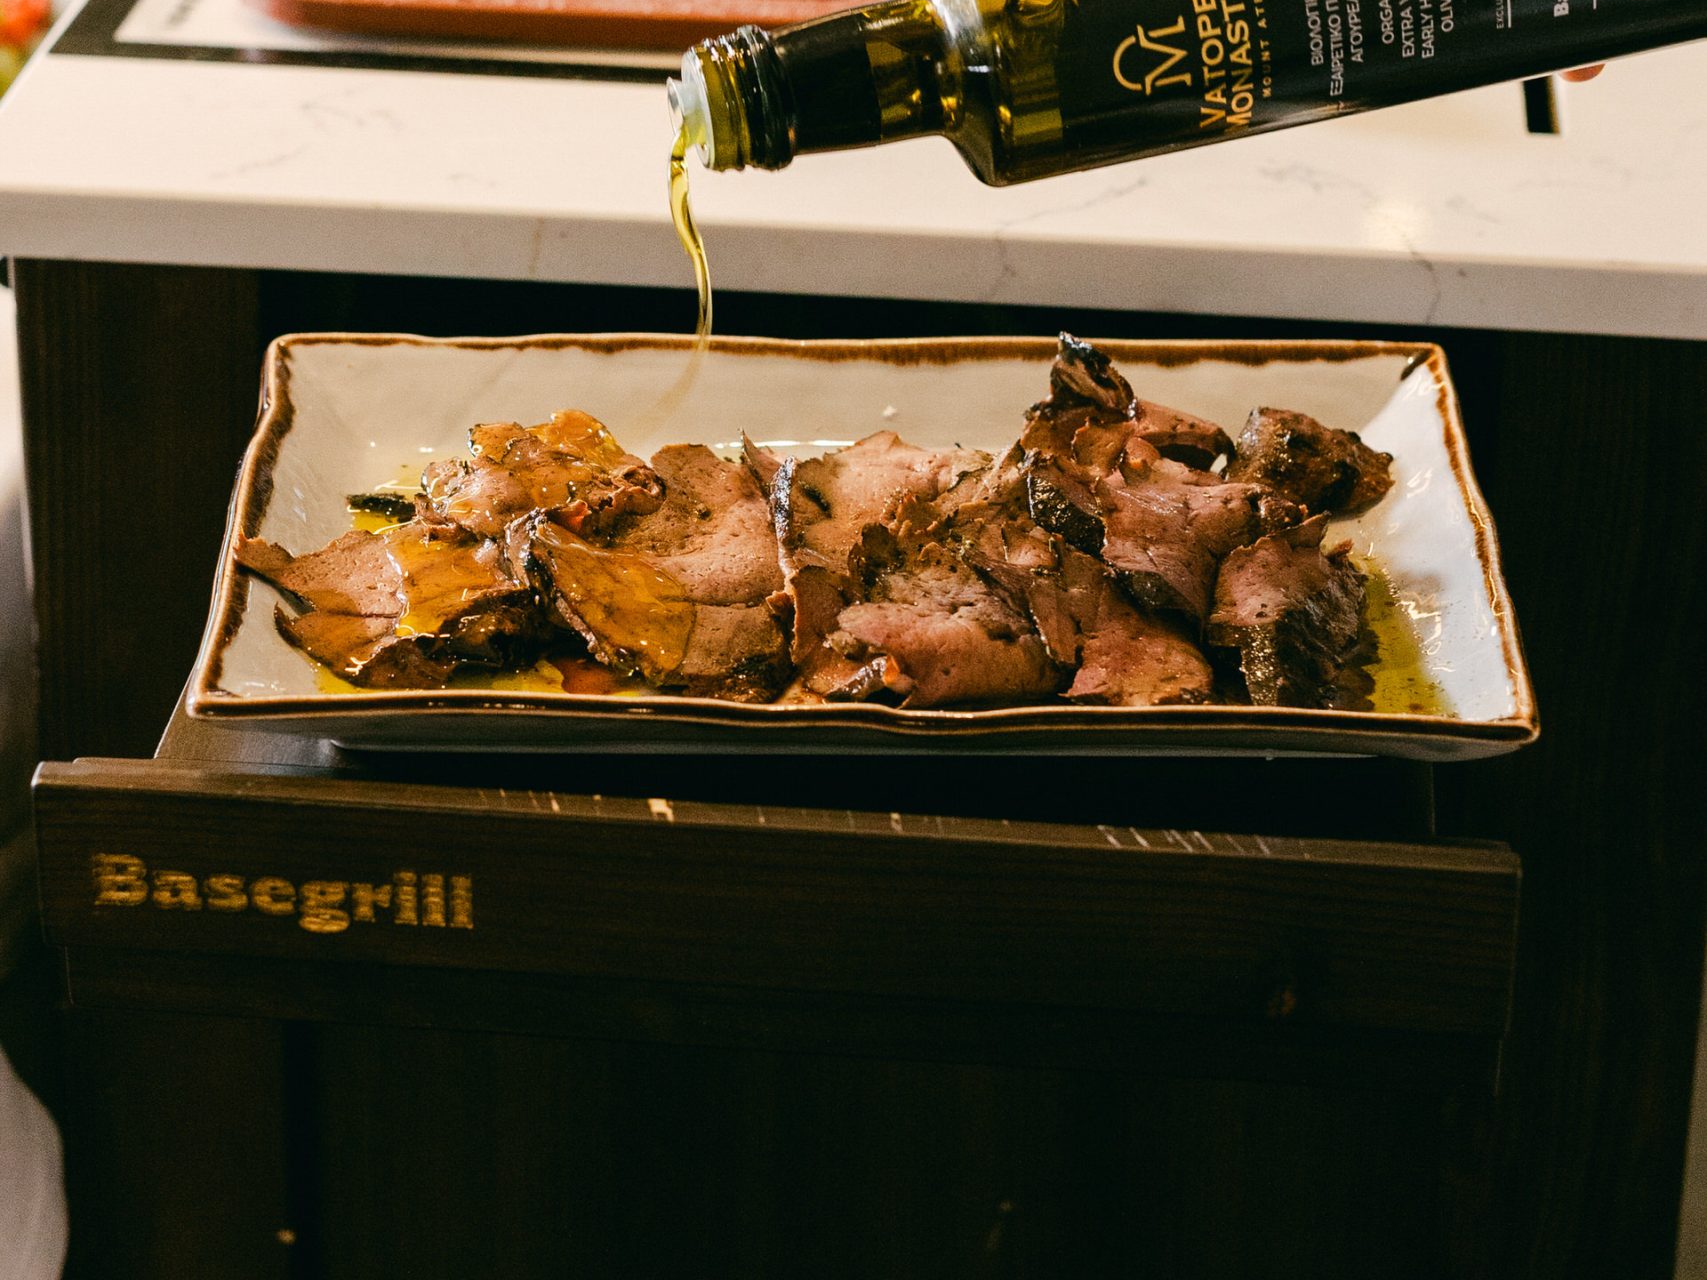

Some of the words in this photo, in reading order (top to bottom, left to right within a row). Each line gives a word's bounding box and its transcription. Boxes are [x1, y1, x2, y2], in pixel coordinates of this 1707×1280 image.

[1400, 6, 1415, 58] EXTRA
[1420, 12, 1434, 59] EARLY
[1259, 39, 1272, 98] MOUNT
[92, 853, 474, 934] Basegrill
